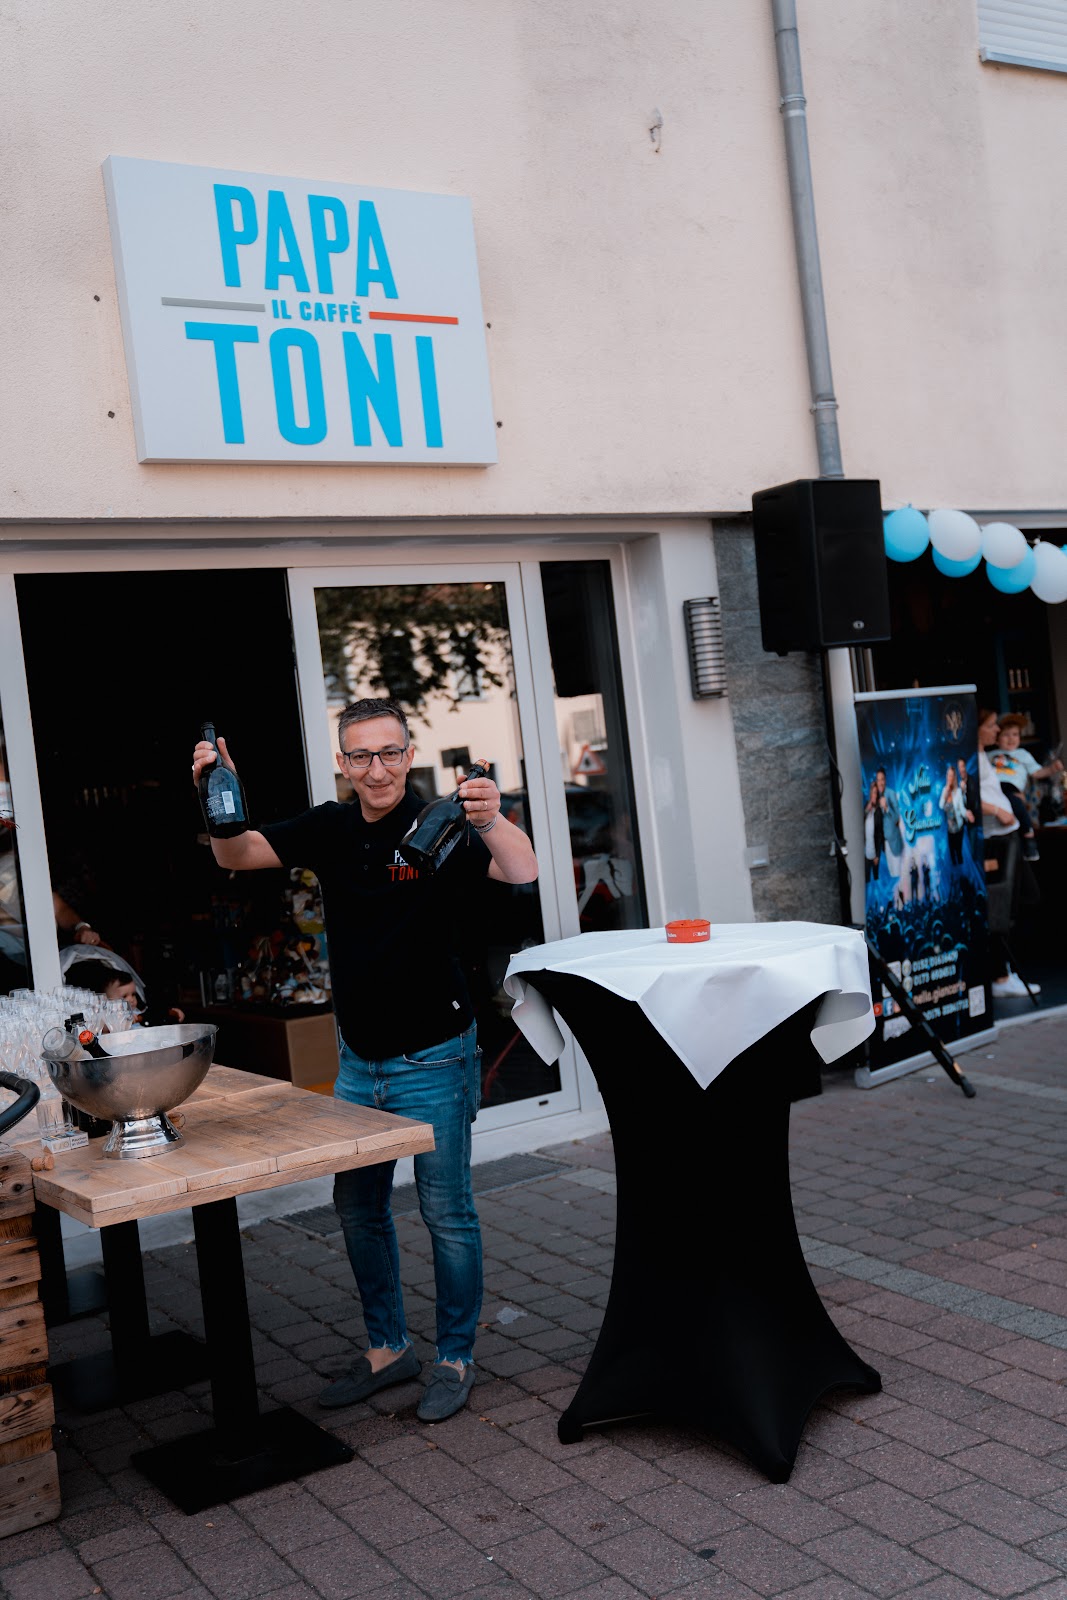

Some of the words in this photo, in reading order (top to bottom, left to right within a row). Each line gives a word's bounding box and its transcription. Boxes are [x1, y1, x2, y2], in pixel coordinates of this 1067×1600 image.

[213, 183, 399, 299] PAPA
[272, 299, 292, 319] IL
[299, 301, 362, 324] CAFFÈ
[184, 321, 444, 448] TONI
